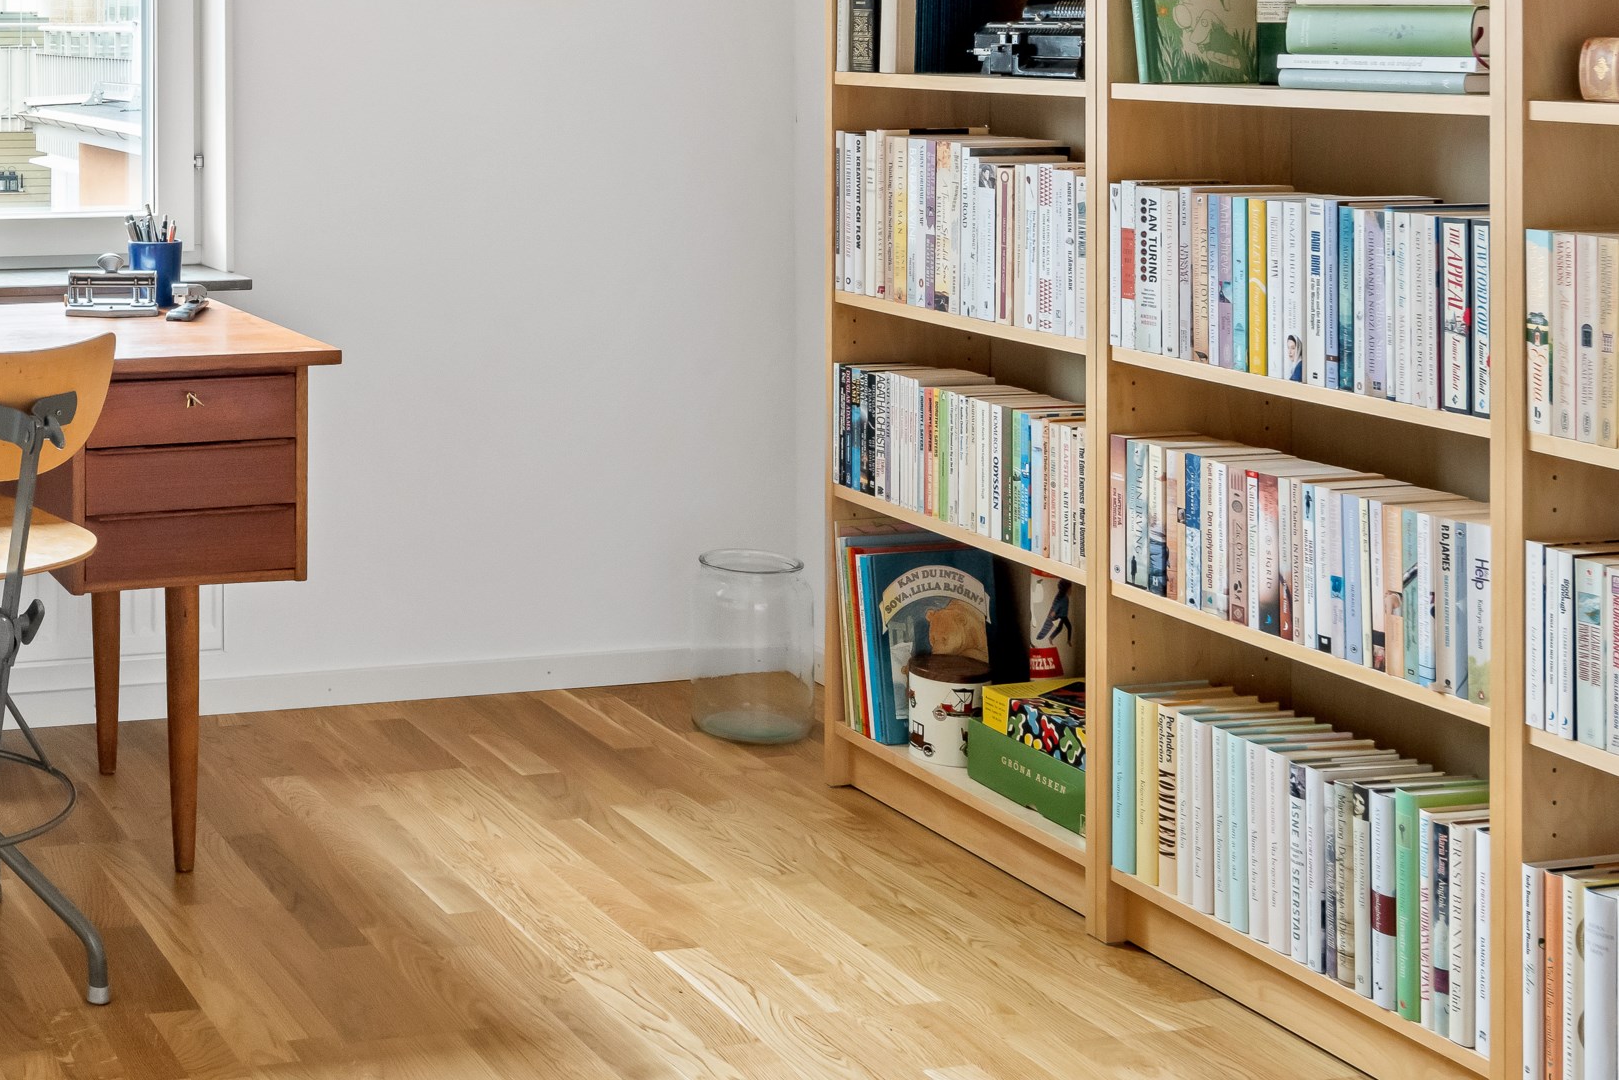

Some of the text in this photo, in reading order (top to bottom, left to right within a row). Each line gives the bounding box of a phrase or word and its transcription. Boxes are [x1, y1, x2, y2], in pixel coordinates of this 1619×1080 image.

[962, 157, 970, 229] UNPAVED ROAD
[1148, 198, 1158, 232] ALAN
[1148, 236, 1158, 284] TURING
[1220, 202, 1230, 274] Anita Shreve
[1288, 207, 1296, 295] BENAZIR BHUTTO
[1310, 230, 1321, 277] HARD DRIVE
[1556, 240, 1564, 287] MANSIONS
[1200, 228, 1208, 321] RACHEL JOYCE
[1447, 227, 1464, 311] THE APPEAL
[1476, 229, 1488, 338] THE TWYFORD CODE
[1565, 240, 1573, 289] CORDUROY
[1415, 312, 1423, 383] HOCUS POCUS
[1451, 336, 1461, 391] Janice Hallett
[1478, 339, 1488, 396] Janice Hallett
[1532, 347, 1547, 402] Emma
[1587, 359, 1595, 402] ALEXANDER
[876, 374, 886, 459] AGATHA CHRISTIE
[992, 411, 1000, 511] HOMEROS ODYSSÉEN
[1062, 442, 1070, 510] SLAPSTICK KURT
[1078, 446, 1086, 460] The
[1078, 459, 1086, 475] Eden
[1078, 476, 1086, 504] Express
[1078, 506, 1086, 526] Mark
[1135, 463, 1144, 555] JOHN IRVING
[1248, 483, 1256, 558] Katarina Mazetti
[1293, 483, 1301, 603] Bruce Chatwin IN PATAGONIA
[1206, 510, 1215, 589] Den upplysta stigen
[1235, 521, 1244, 574] Zac O'Yeah
[1439, 524, 1451, 573] P.D. JAMES
[884, 582, 984, 614] SOVA, LILLA BJÖRN?
[897, 569, 966, 588] KAN DU INTE
[1471, 558, 1490, 591] Help
[1559, 583, 1567, 615] enough
[1563, 578, 1572, 600] good
[1476, 599, 1484, 650] Kathryn Stockett
[1030, 657, 1056, 671] ZZLE
[1578, 622, 1590, 682] PAYMENT IN BLOOD
[1590, 625, 1601, 688] ELIZABETH GEORGE
[1158, 712, 1166, 764] Fogelström
[1165, 715, 1175, 763] Per Anders
[1001, 756, 1067, 795] GRÖNA ASKEN
[1158, 768, 1177, 861] KOMIKERN
[1291, 801, 1302, 838] ÅSNE
[1337, 793, 1347, 840] Maria Lang
[1438, 833, 1448, 876] Maria Lang
[1291, 869, 1301, 941] SEIERSTAD
[1451, 838, 1463, 1014] ERNST BRUNNER Edith
